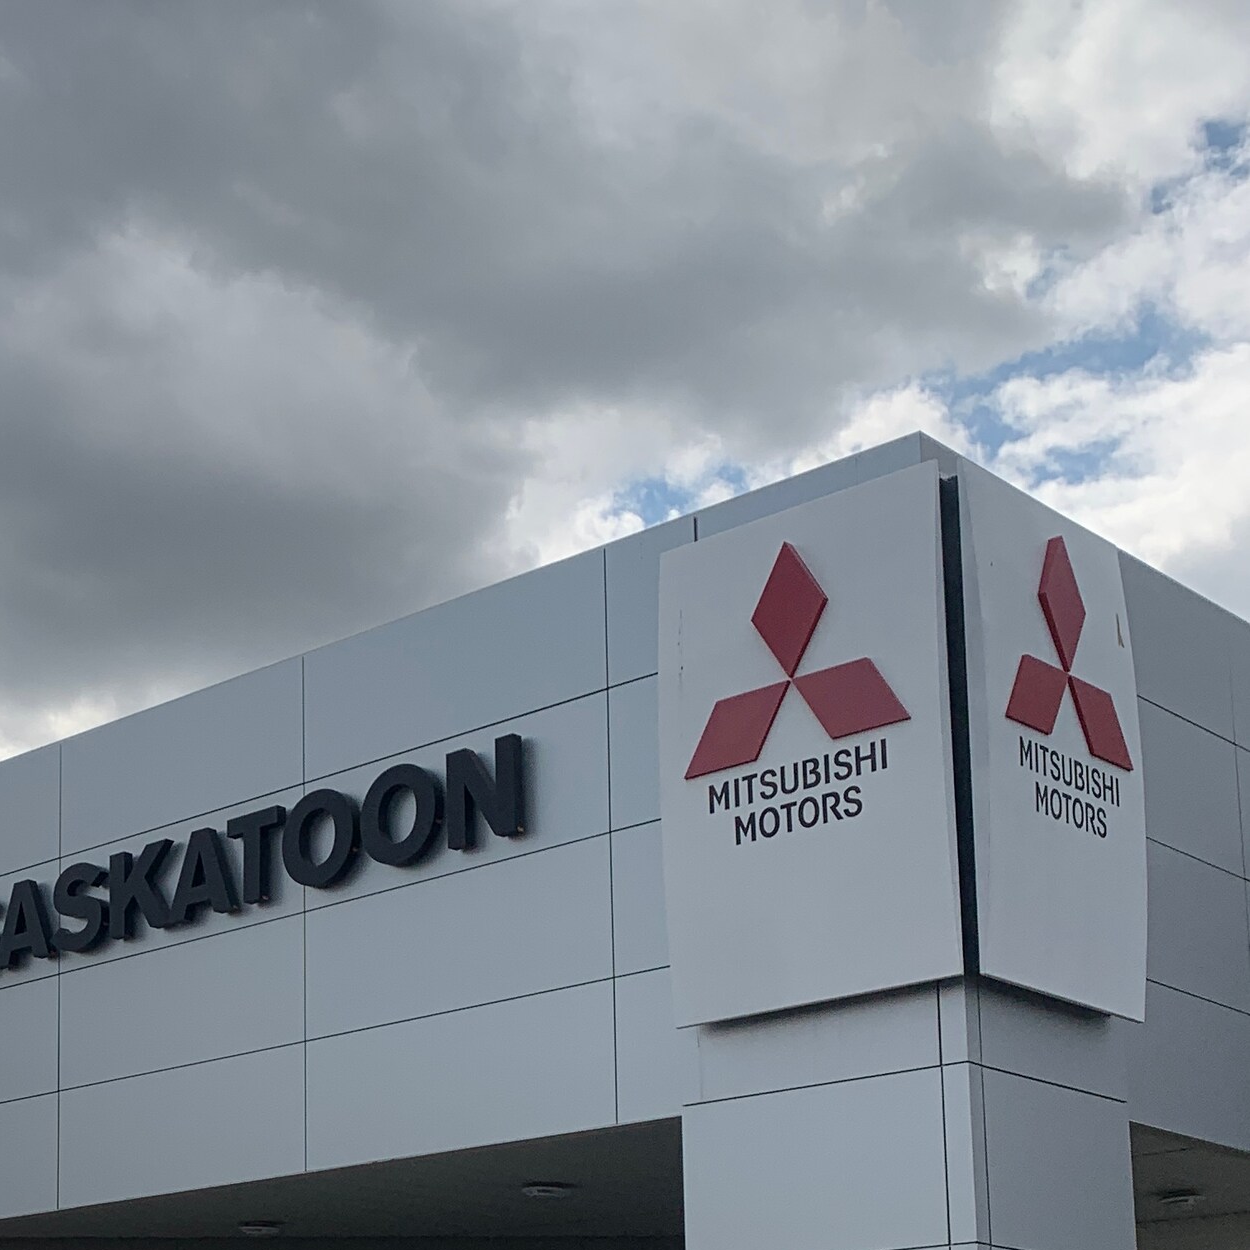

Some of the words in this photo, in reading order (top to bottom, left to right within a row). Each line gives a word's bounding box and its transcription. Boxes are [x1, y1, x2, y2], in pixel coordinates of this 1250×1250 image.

[708, 737, 889, 814] MITSUBISHI
[1018, 736, 1121, 807] MITSUBISHI
[734, 785, 863, 846] MOTORS
[1035, 781, 1108, 839] MOTORS
